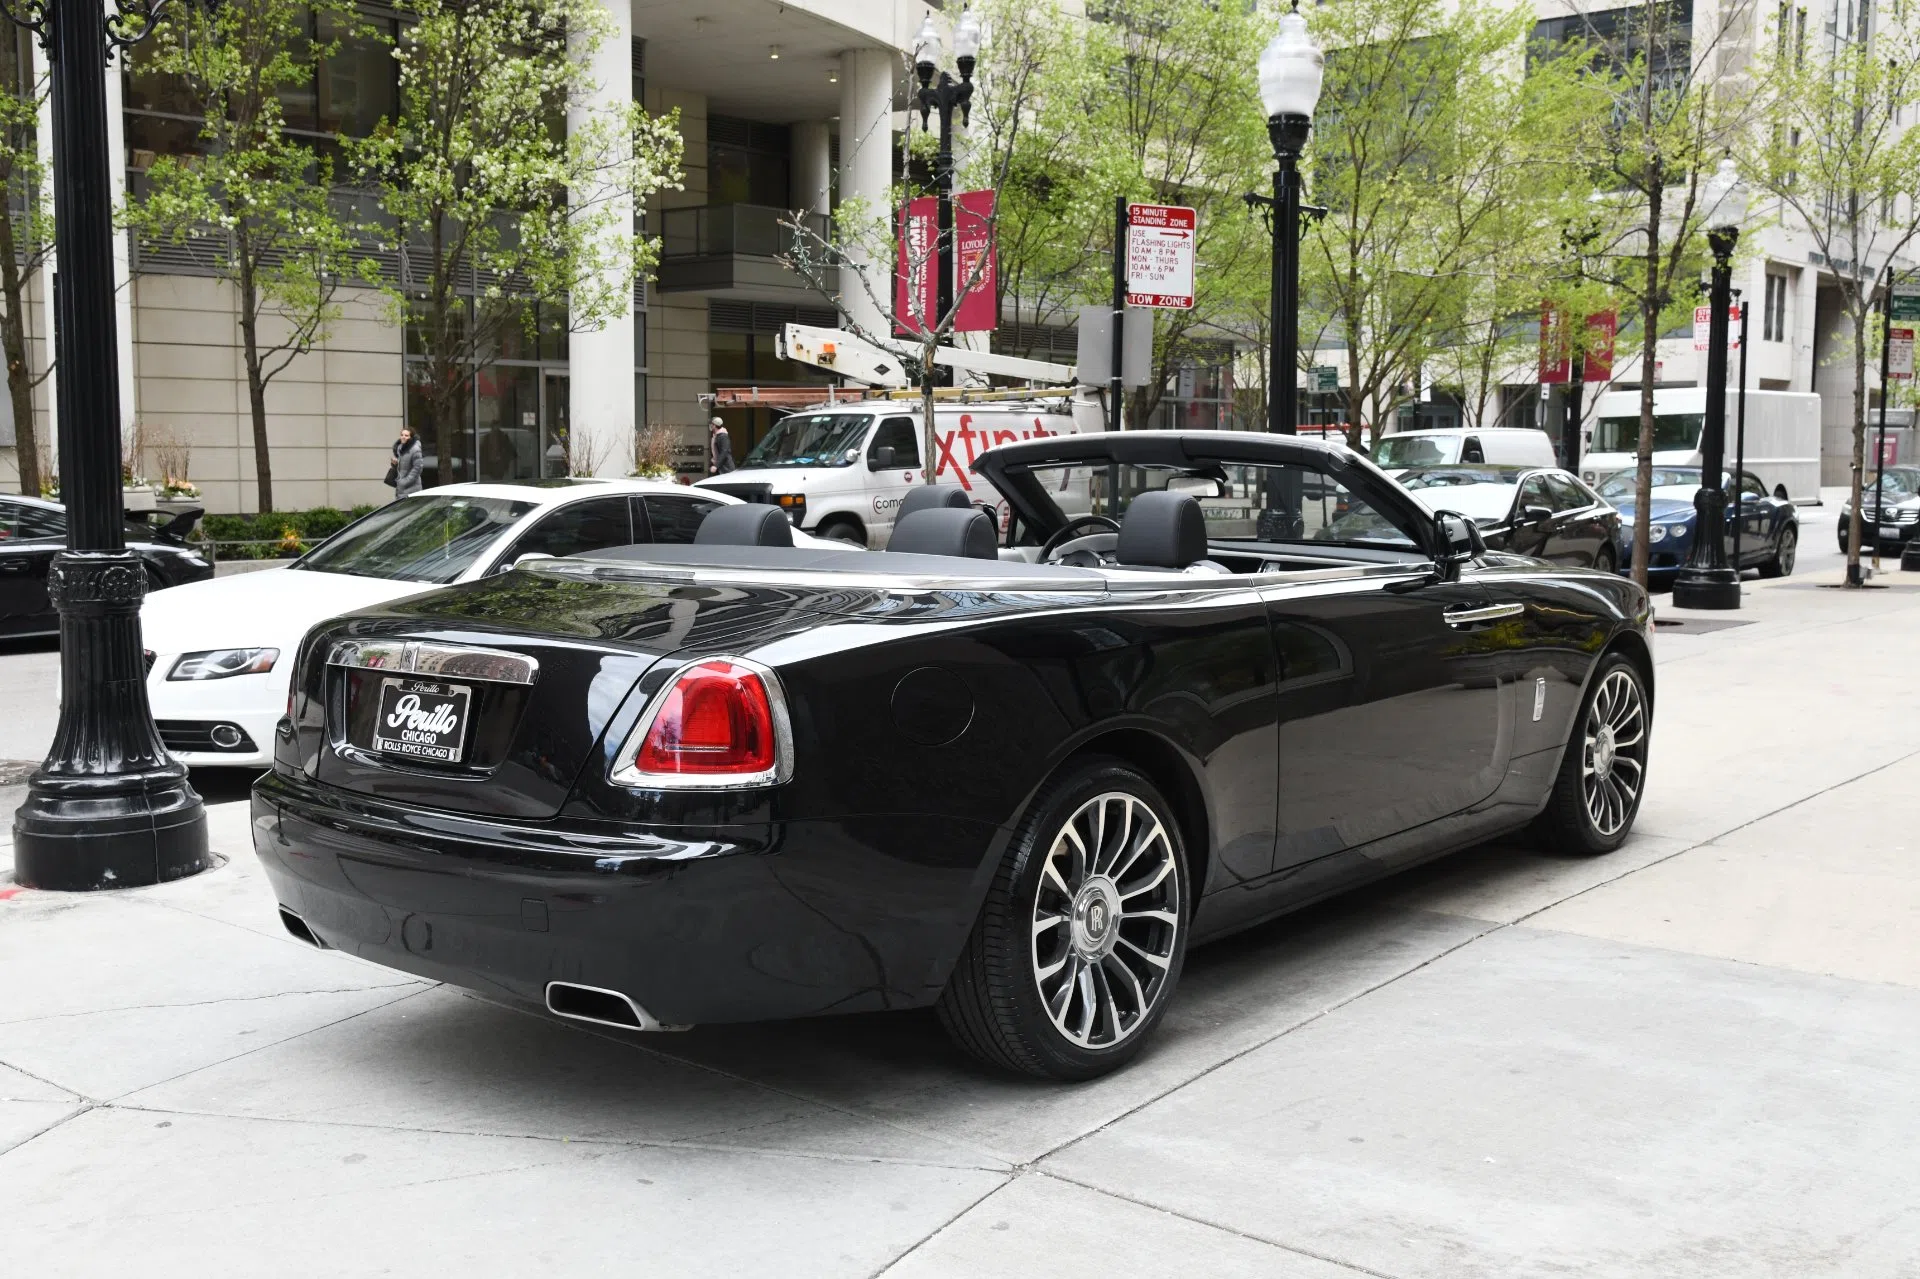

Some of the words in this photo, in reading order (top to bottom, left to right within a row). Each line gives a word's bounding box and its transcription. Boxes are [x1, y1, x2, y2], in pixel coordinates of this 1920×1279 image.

[1133, 207, 1140, 215] 15
[1142, 208, 1168, 217] MINUTE
[1132, 216, 1167, 226] STANDING
[1170, 218, 1188, 228] ZONE
[1132, 238, 1166, 248] FLASHING
[1167, 240, 1191, 250] LIGHTS
[907, 215, 921, 317] WLOME
[1156, 256, 1179, 265] THURS
[1158, 265, 1163, 273] 6
[1130, 294, 1154, 304] TOW
[1158, 295, 1188, 307] ZONE
[934, 414, 1077, 491] xfit
[411, 681, 440, 693] Perillo
[387, 694, 458, 735] Perillo
[401, 729, 437, 745] CHICAGO
[383, 740, 401, 751] ROLLS
[402, 743, 421, 755] ROYCE
[421, 746, 448, 758] CHICAGO
